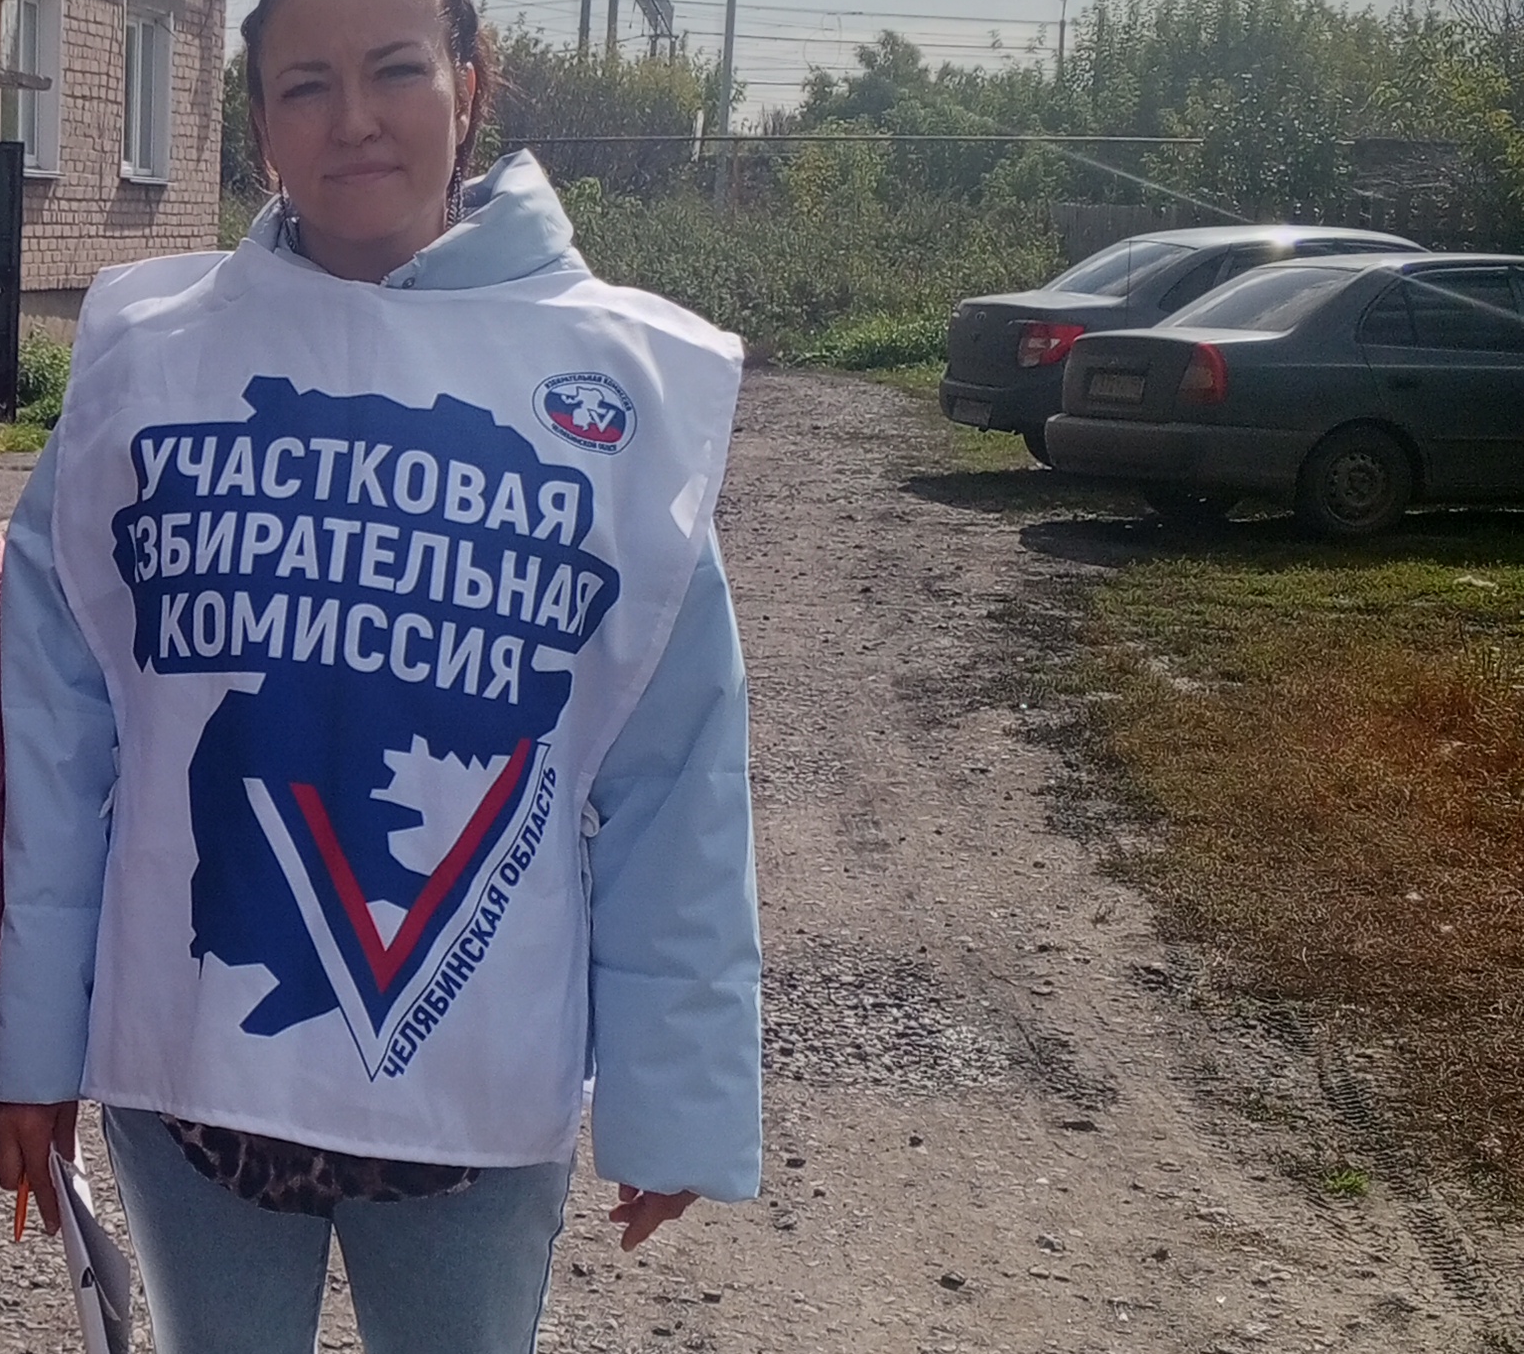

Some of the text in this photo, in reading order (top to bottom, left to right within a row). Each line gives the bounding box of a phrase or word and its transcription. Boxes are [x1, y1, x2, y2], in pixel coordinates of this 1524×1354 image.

[140, 436, 580, 546] УЧАСТКОВАЯ
[158, 591, 525, 705] КОМИССИЯ
[382, 766, 556, 1079] ЧЕЛЯБИНСКАЯ ОБЛАСТЬ
